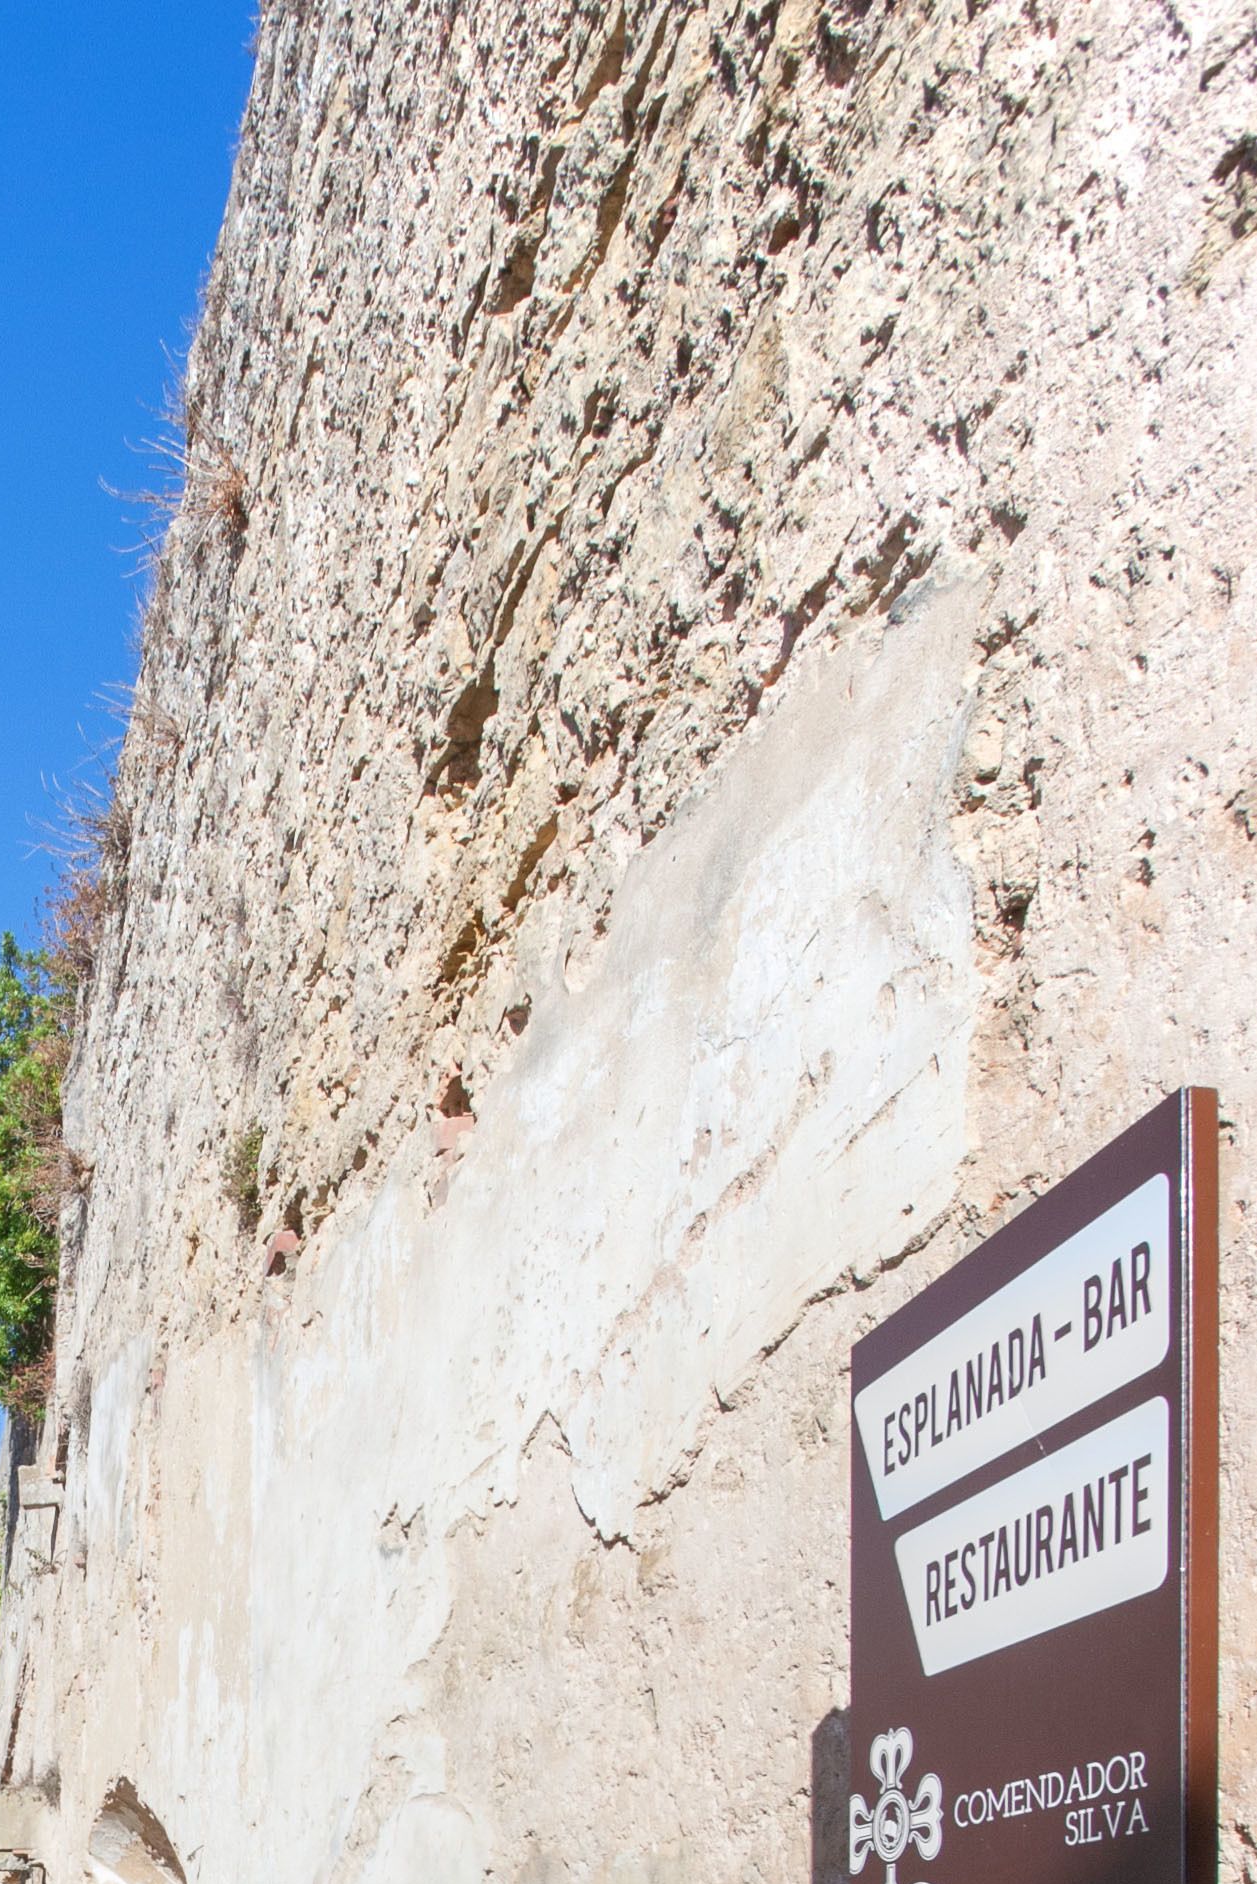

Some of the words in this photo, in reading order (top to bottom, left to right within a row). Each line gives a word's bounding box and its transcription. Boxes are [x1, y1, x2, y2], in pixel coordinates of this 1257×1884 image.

[1083, 1241, 1152, 1353] BAR
[926, 1452, 1152, 1627] RESTAURANTE
[953, 1751, 1148, 1828] COMENDADOR
[1064, 1798, 1149, 1846] SILVA
